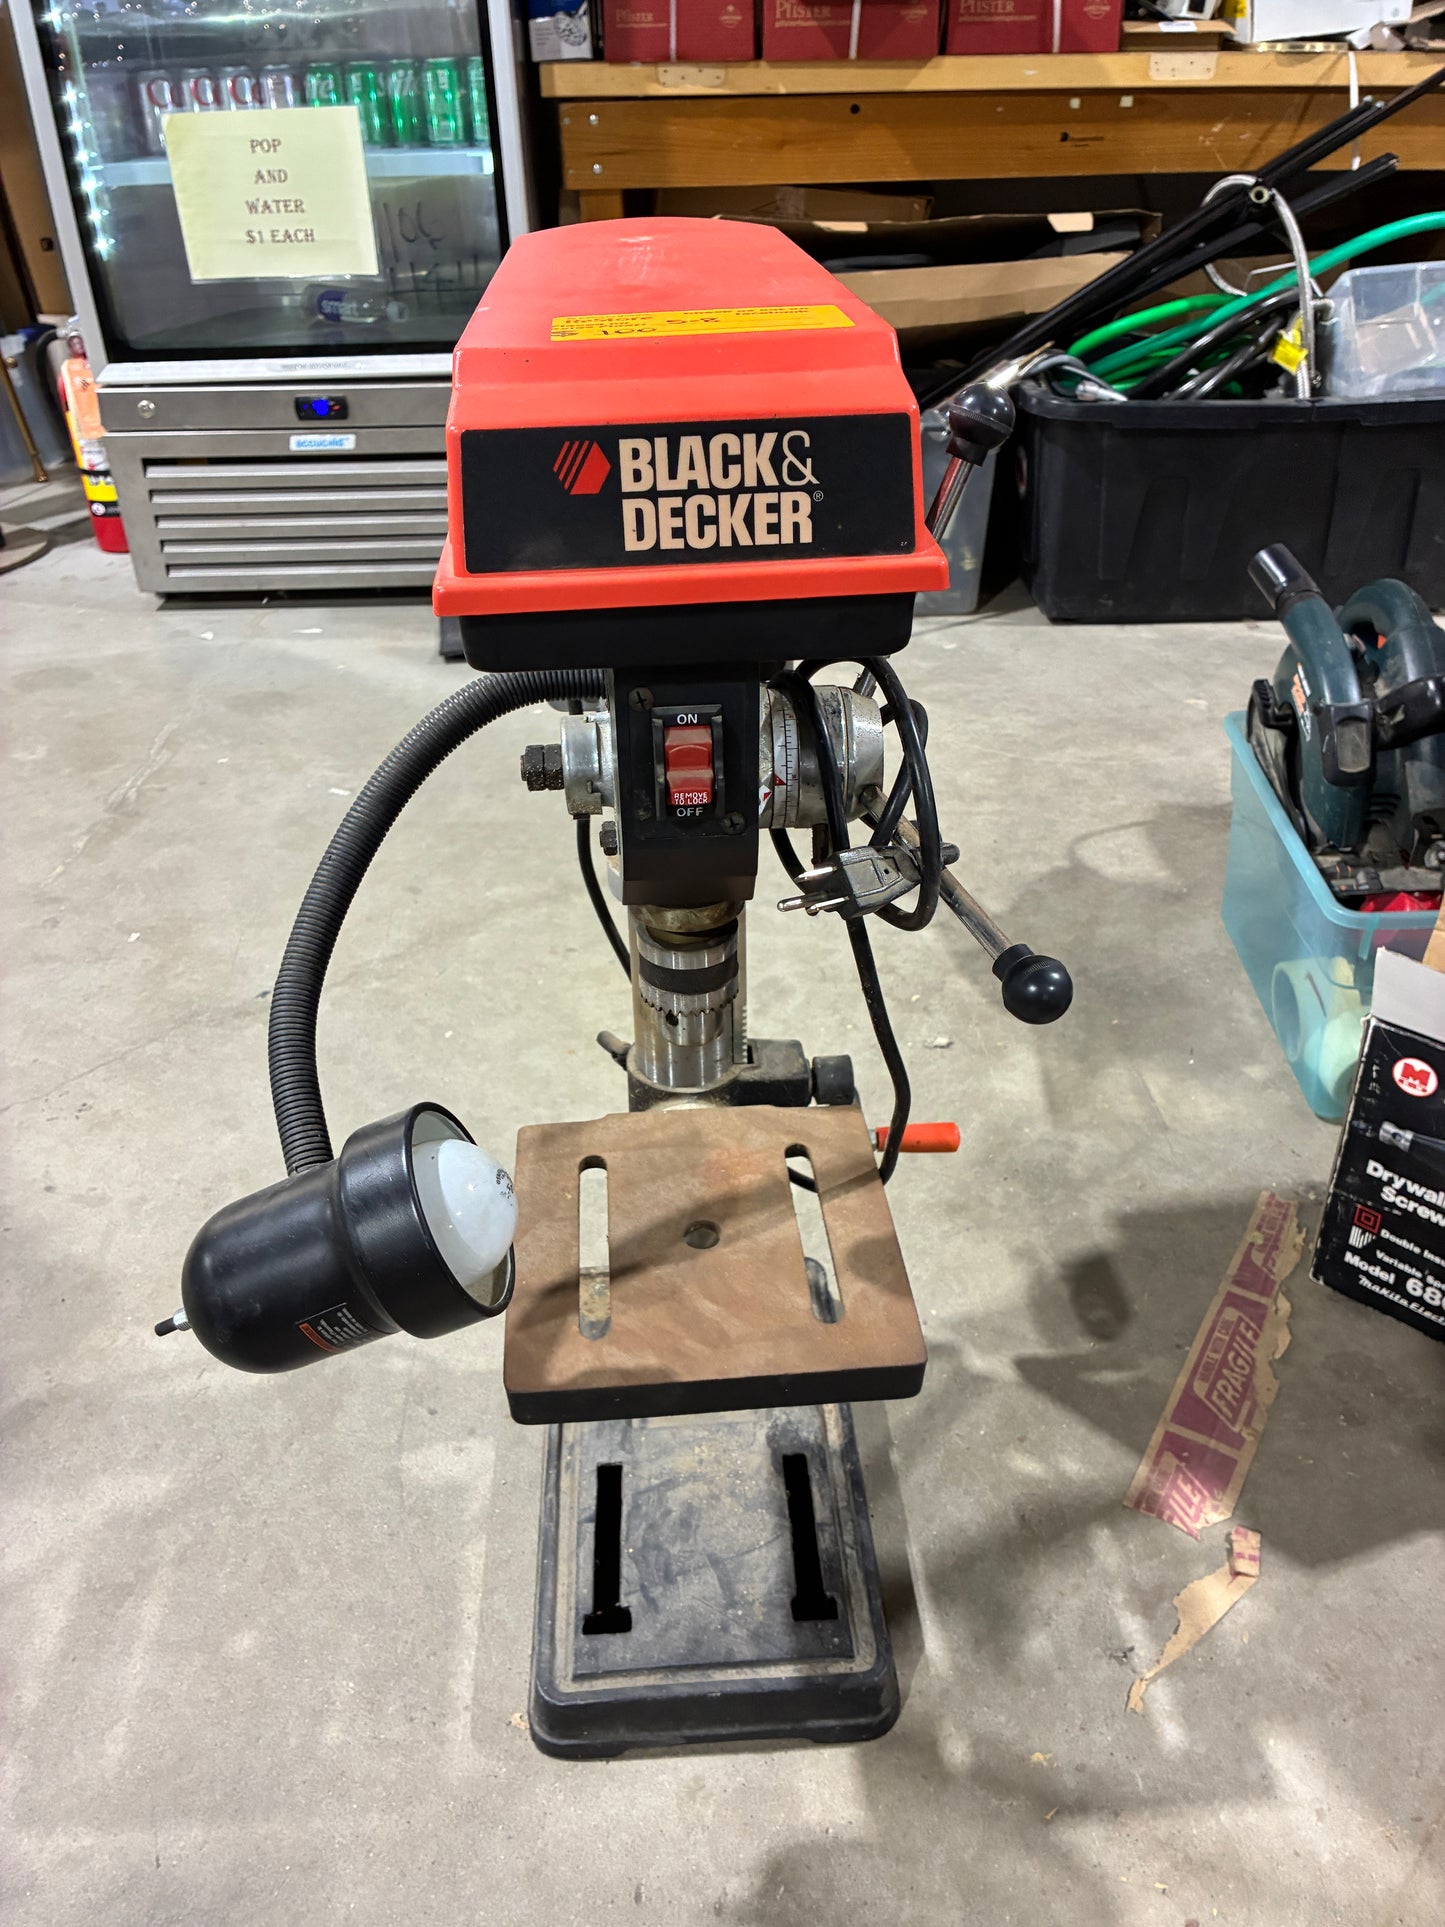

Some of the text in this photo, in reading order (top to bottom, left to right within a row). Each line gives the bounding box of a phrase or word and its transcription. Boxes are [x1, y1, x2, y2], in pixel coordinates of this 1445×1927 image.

[249, 139, 282, 154] POP
[254, 168, 288, 185] AND
[245, 198, 306, 215] WATER
[245, 228, 315, 244] $1 EACH
[677, 713, 698, 725] ON
[674, 791, 708, 800] REMOVE
[674, 797, 708, 806] TO LOCK
[676, 806, 704, 817] OFF
[1380, 1228, 1422, 1254] Double
[1376, 1249, 1423, 1279] Variable
[1344, 1250, 1445, 1311] Model 68
[1358, 1274, 1409, 1308] Makita
